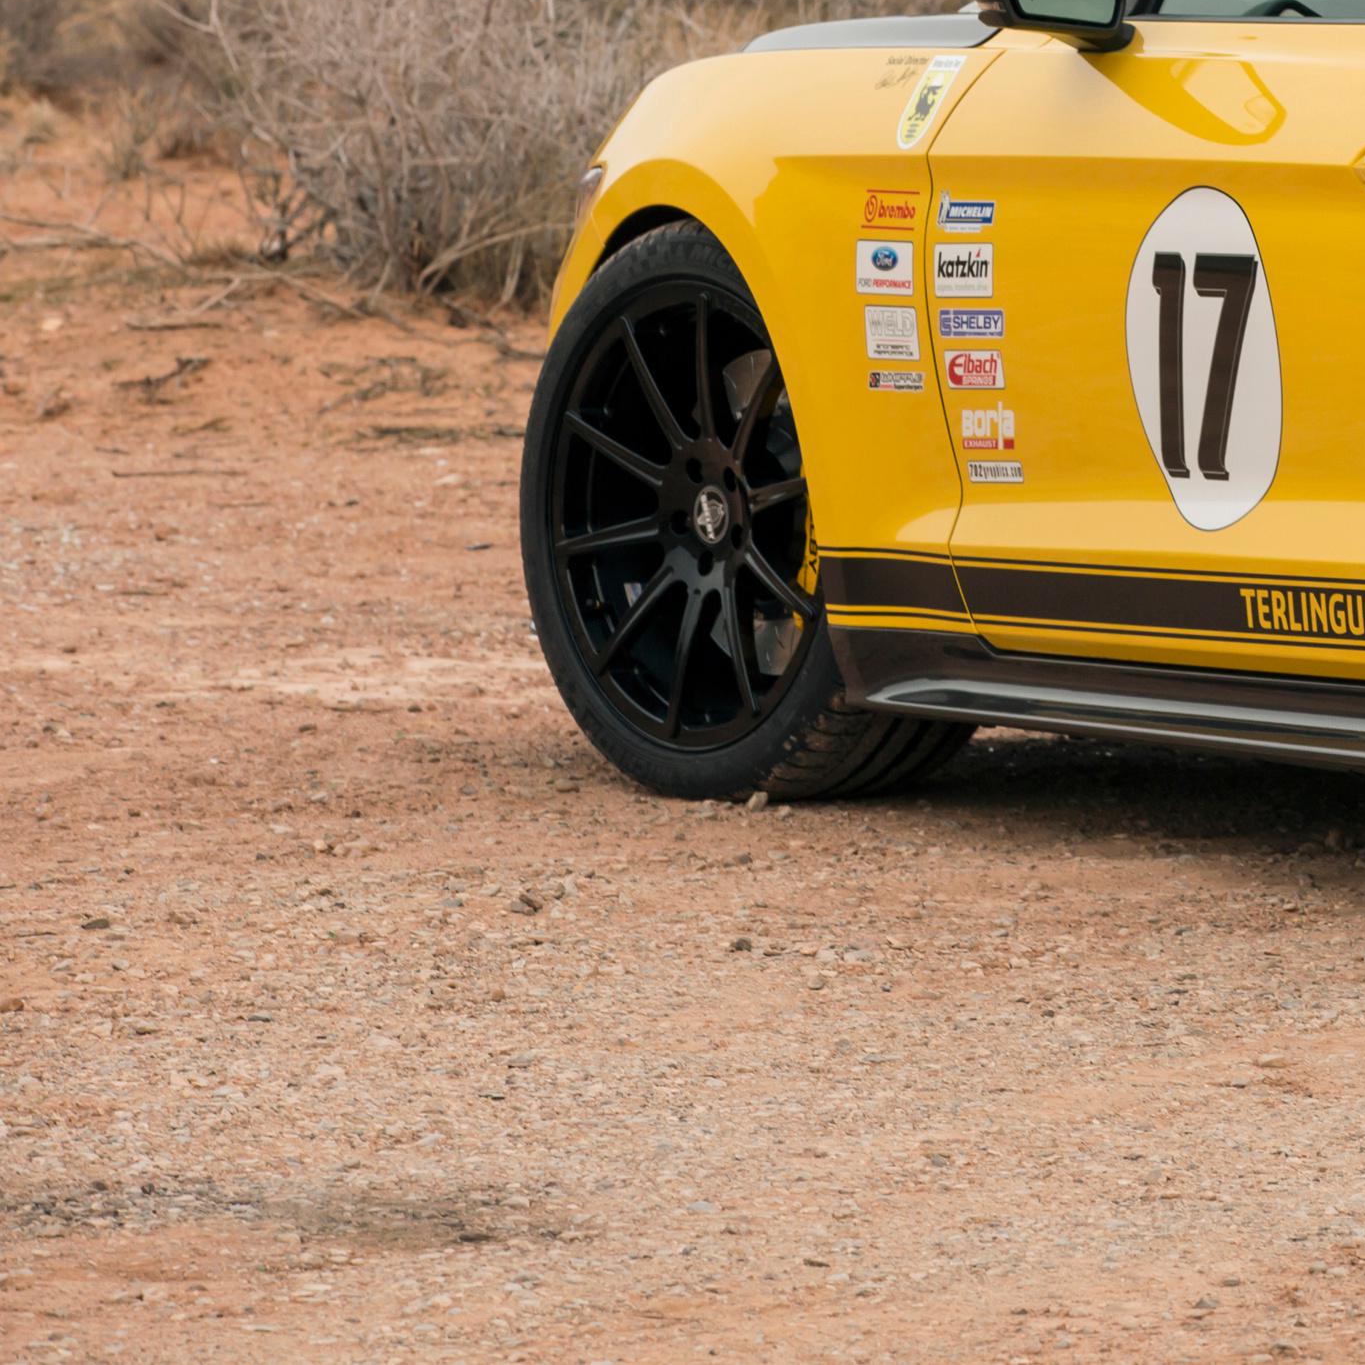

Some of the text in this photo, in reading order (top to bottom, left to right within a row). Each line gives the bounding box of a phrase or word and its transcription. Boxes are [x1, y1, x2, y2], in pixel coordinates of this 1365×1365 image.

[878, 200, 916, 219] brembo
[949, 206, 993, 218] MICHELIN
[937, 249, 988, 279] katzkin
[867, 309, 915, 337] WELD
[953, 316, 1000, 330] SHELBY
[1152, 251, 1258, 482] 17
